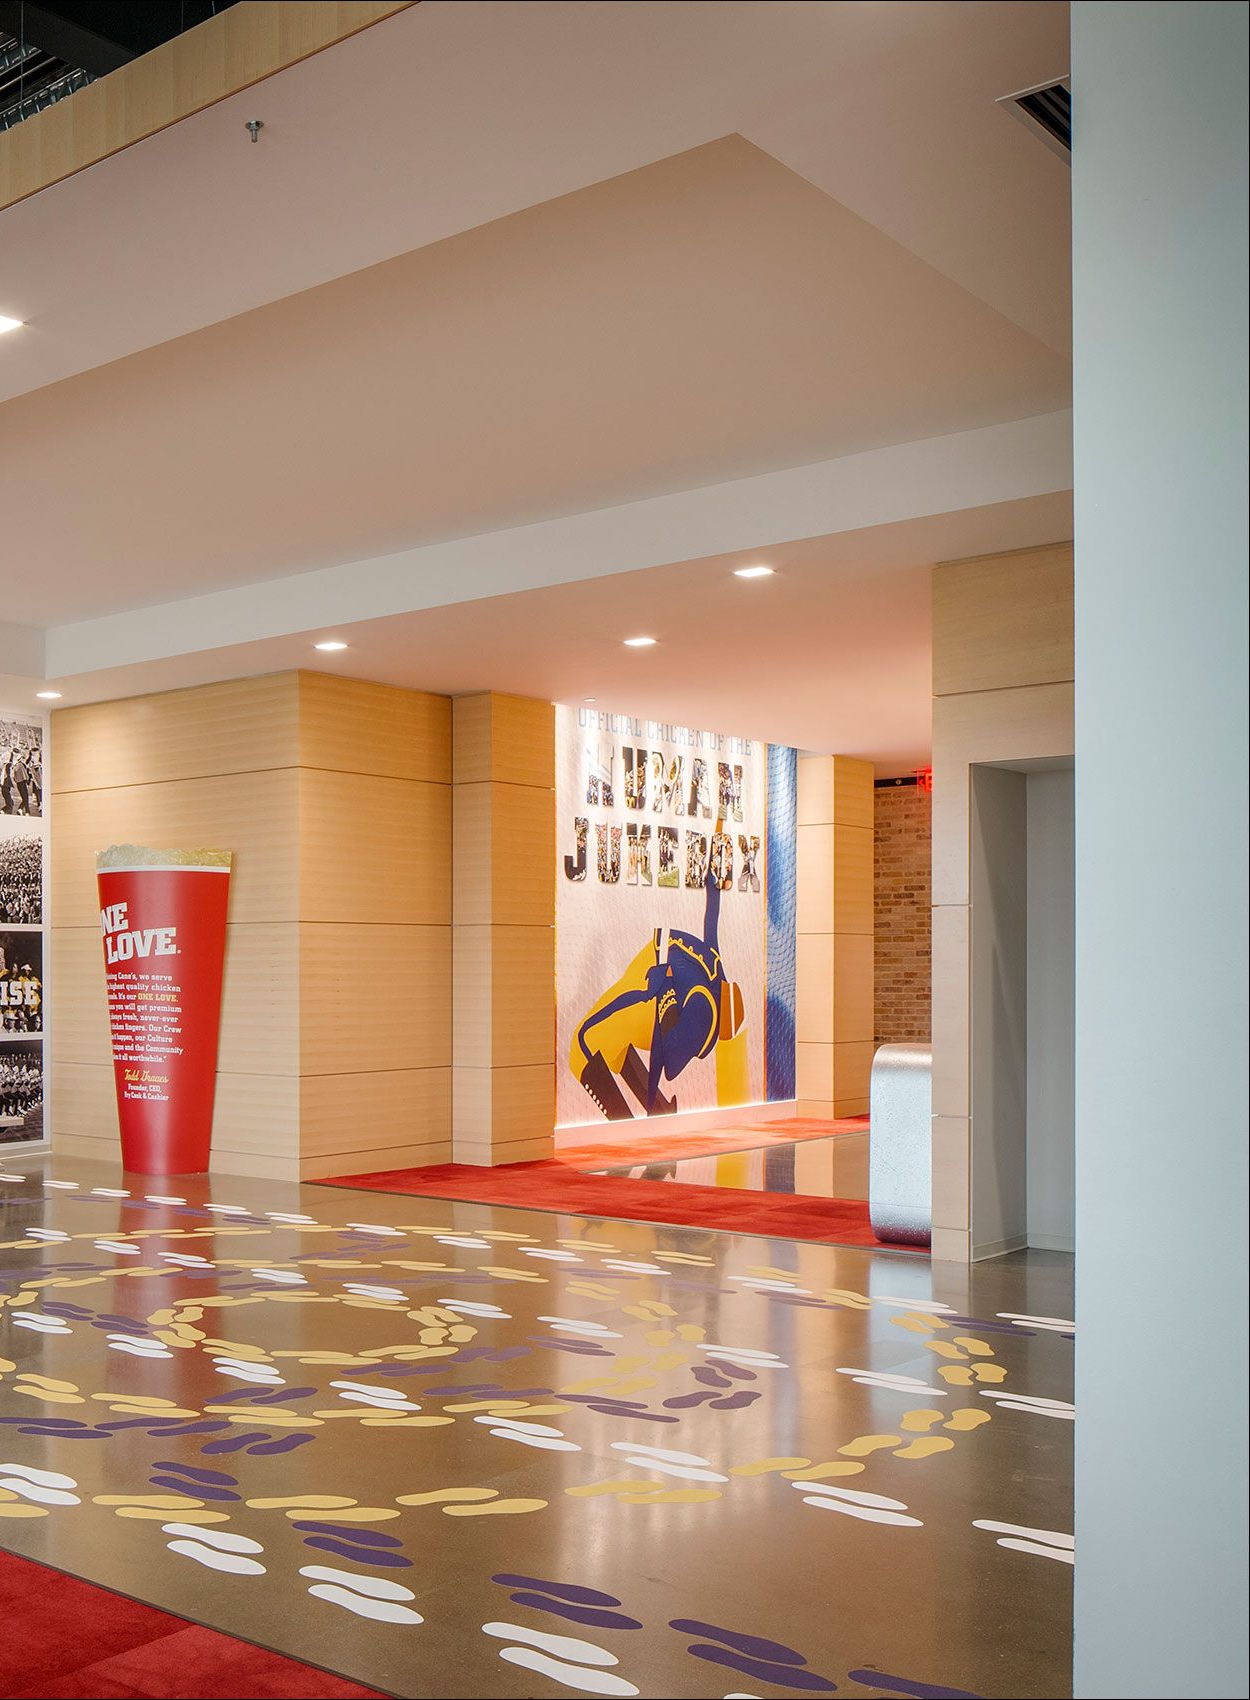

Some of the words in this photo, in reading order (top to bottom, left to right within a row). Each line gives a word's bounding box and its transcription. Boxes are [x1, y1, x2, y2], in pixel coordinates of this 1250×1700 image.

[579, 707, 642, 737] OFFICIAL
[647, 719, 704, 750] CHICKEN
[709, 731, 724, 752] OF
[729, 736, 752, 757] THE
[586, 744, 744, 823] HUMAN
[563, 817, 761, 894] JUKEBOX
[101, 902, 128, 935] NE
[106, 927, 181, 965] LOVE.
[125, 983, 149, 991] quality
[151, 984, 181, 992] chicken
[138, 993, 154, 1001] ONE
[155, 993, 179, 1002] LOVE.
[137, 1004, 148, 1012] get
[149, 1005, 182, 1013] premium
[123, 1013, 139, 1021] fresh,
[140, 1015, 179, 1023] never-ever
[148, 1024, 162, 1032] Our
[163, 1025, 182, 1033] Crew
[147, 1034, 173, 1043] Culture
[145, 1044, 184, 1056] Community
[124, 1068, 140, 1081] Todd
[140, 1070, 169, 1083] Graves
[128, 1083, 148, 1092] Founder,
[149, 1085, 161, 1093] CEO,
[147, 1092, 170, 1101] Cashier
